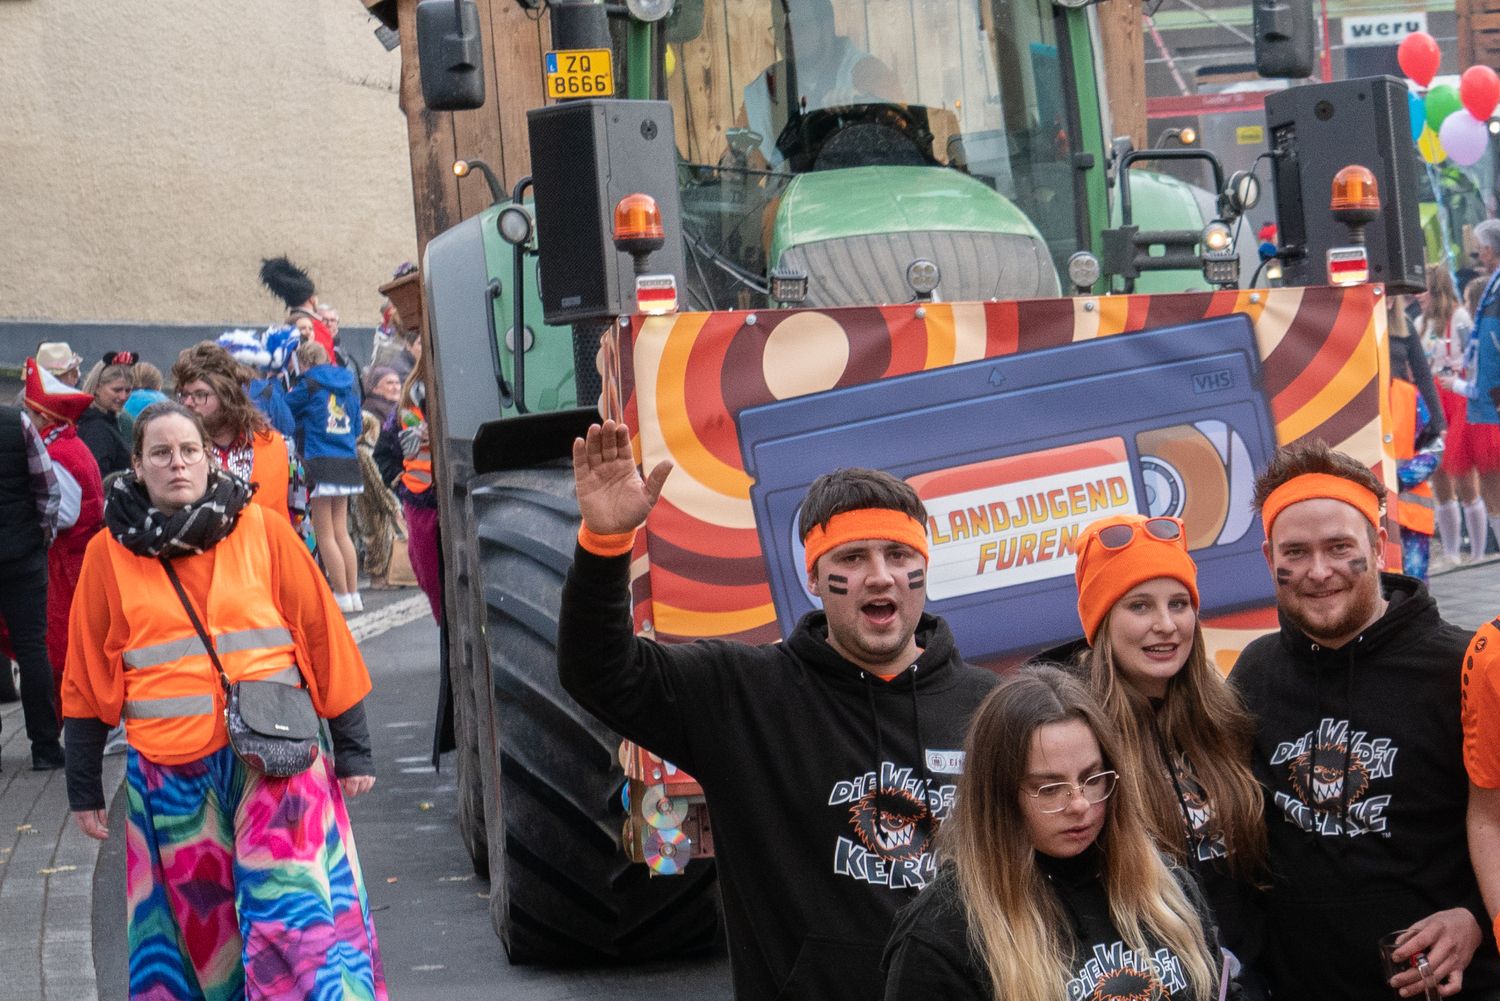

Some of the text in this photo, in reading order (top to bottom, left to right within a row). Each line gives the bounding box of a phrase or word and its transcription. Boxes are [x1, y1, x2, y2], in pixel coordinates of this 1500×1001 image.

[1351, 20, 1420, 38] weru
[555, 75, 606, 94] 8666
[1195, 369, 1231, 388] VHS
[928, 475, 1130, 546] LANDJUGEND
[834, 836, 937, 890] KERL
